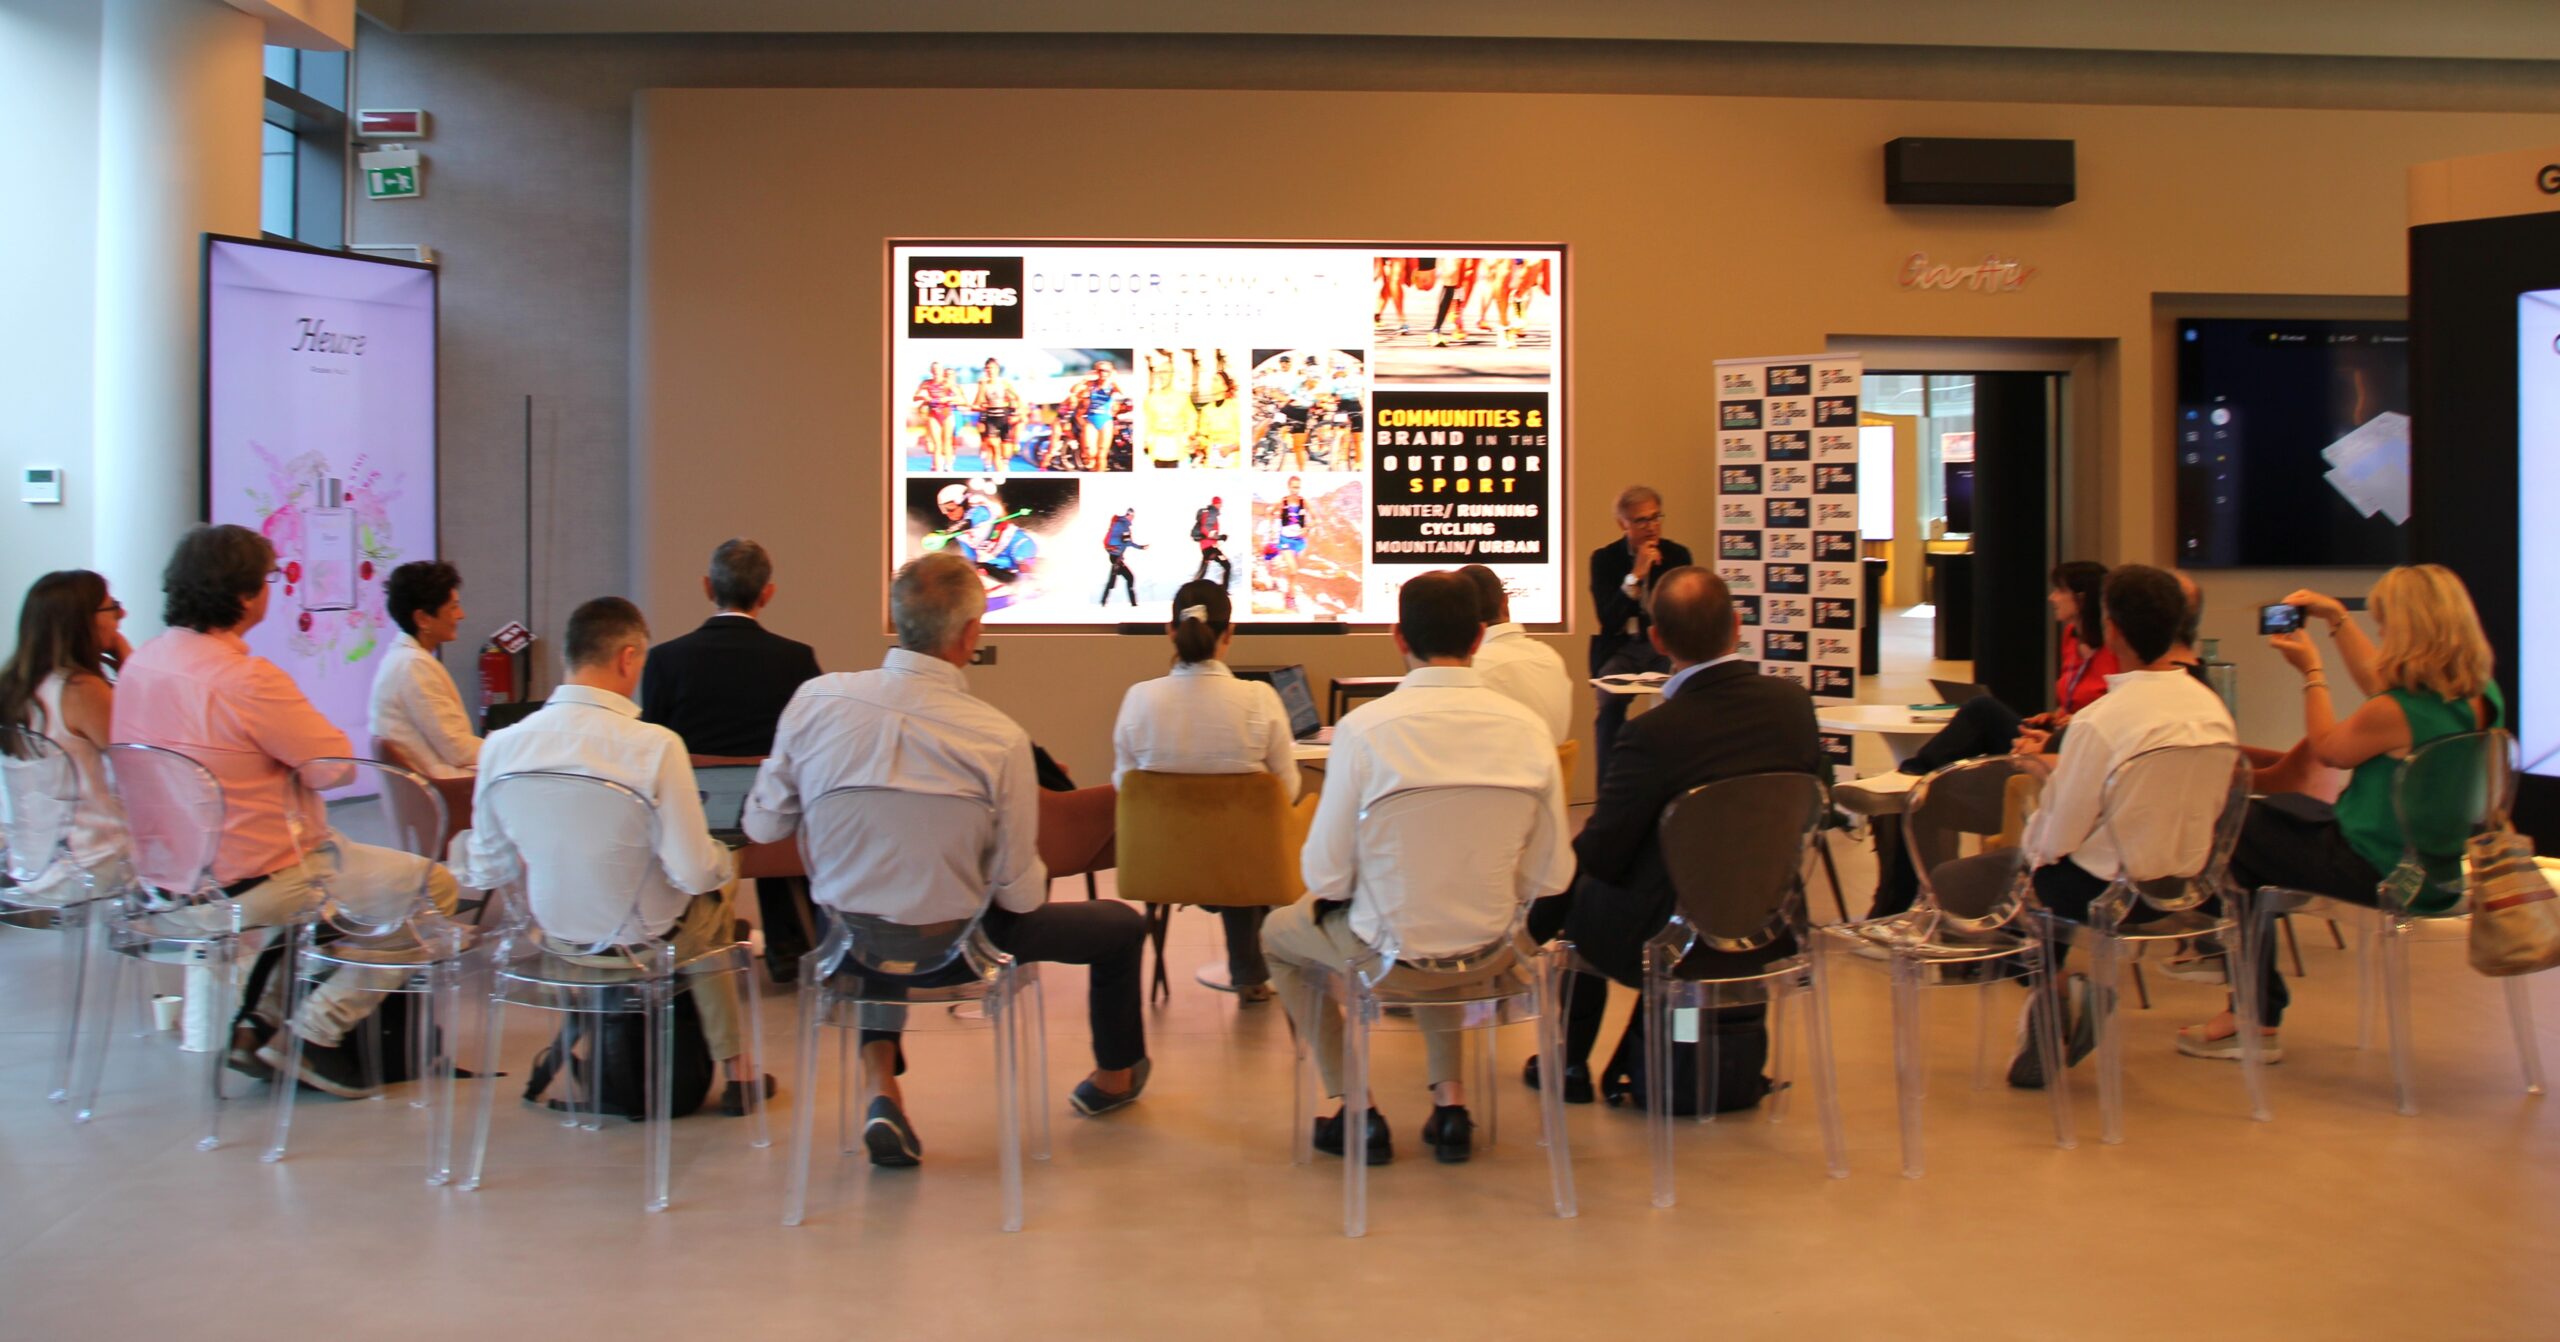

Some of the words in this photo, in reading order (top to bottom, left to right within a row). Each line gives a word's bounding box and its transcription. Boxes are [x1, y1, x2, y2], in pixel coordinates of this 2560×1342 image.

[914, 269, 990, 288] SPORT
[1032, 273, 1162, 293] OUTDOOR
[918, 287, 1018, 306] LEADERS
[914, 305, 992, 324] FORUM
[1378, 409, 1521, 428] COMMUNITIES
[1525, 409, 1543, 428] &
[1376, 430, 1464, 446] BRAND
[1475, 434, 1498, 446] IN
[1508, 434, 1547, 446] THE
[1383, 455, 1541, 472] OUTDOOR
[1409, 477, 1516, 493] SPORT
[1376, 503, 1454, 519] WINTER/
[1457, 504, 1539, 517] RUNNING
[1420, 522, 1496, 535] CYCLING
[1375, 539, 1476, 555] MOUNTAIN/
[1479, 540, 1541, 553] URBAN
